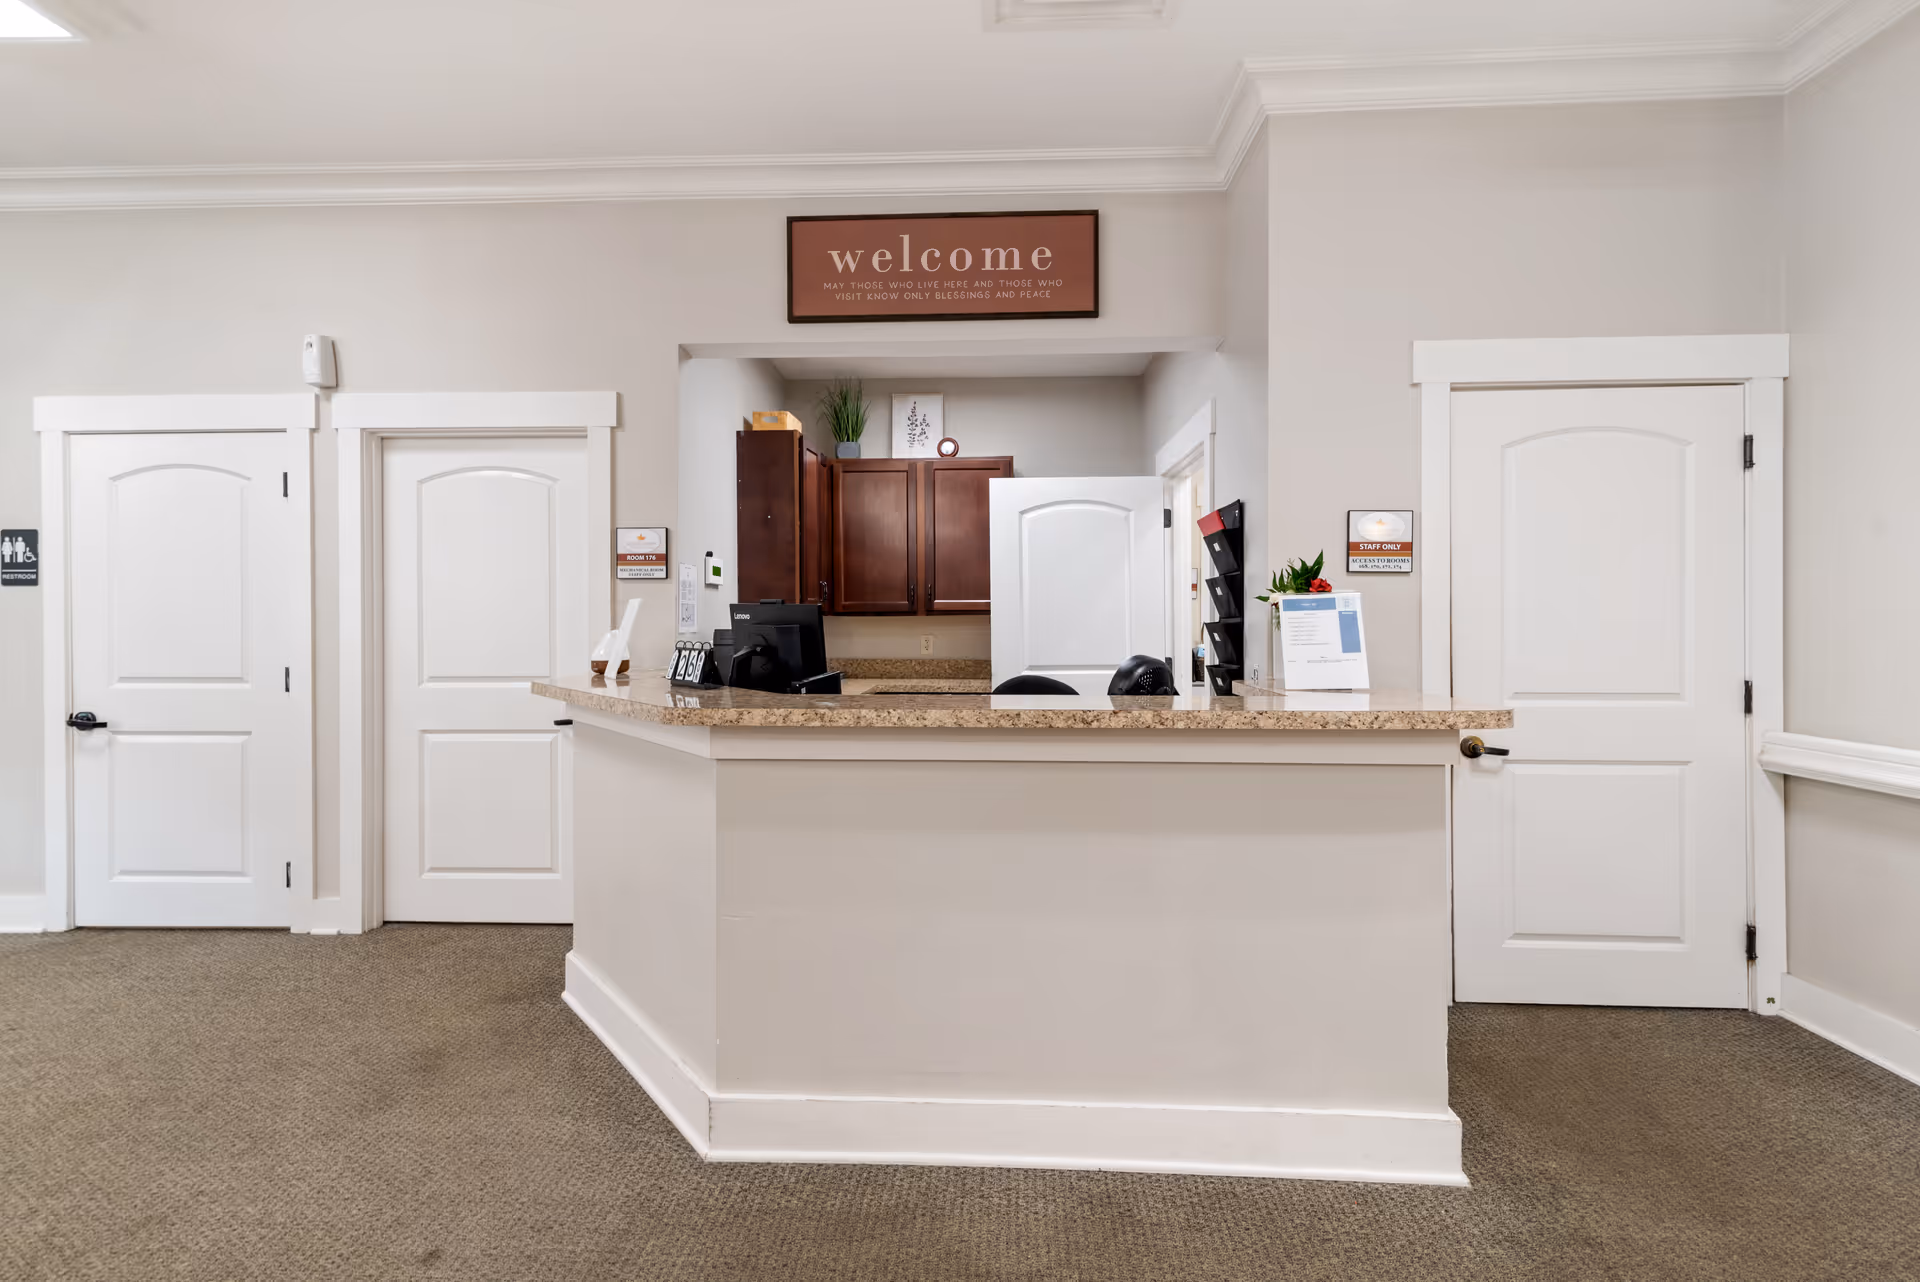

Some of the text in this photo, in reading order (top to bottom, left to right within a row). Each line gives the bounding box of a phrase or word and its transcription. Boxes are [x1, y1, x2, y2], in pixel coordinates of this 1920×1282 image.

[827, 234, 1052, 274] welcome
[824, 279, 1062, 290] MAY THOSE WHO LIVE HERE AND THOSE WHO
[835, 290, 1050, 300] VISIT KNOW ONLY BLESSINGS AND PEACE
[733, 612, 751, 620] Lenovo
